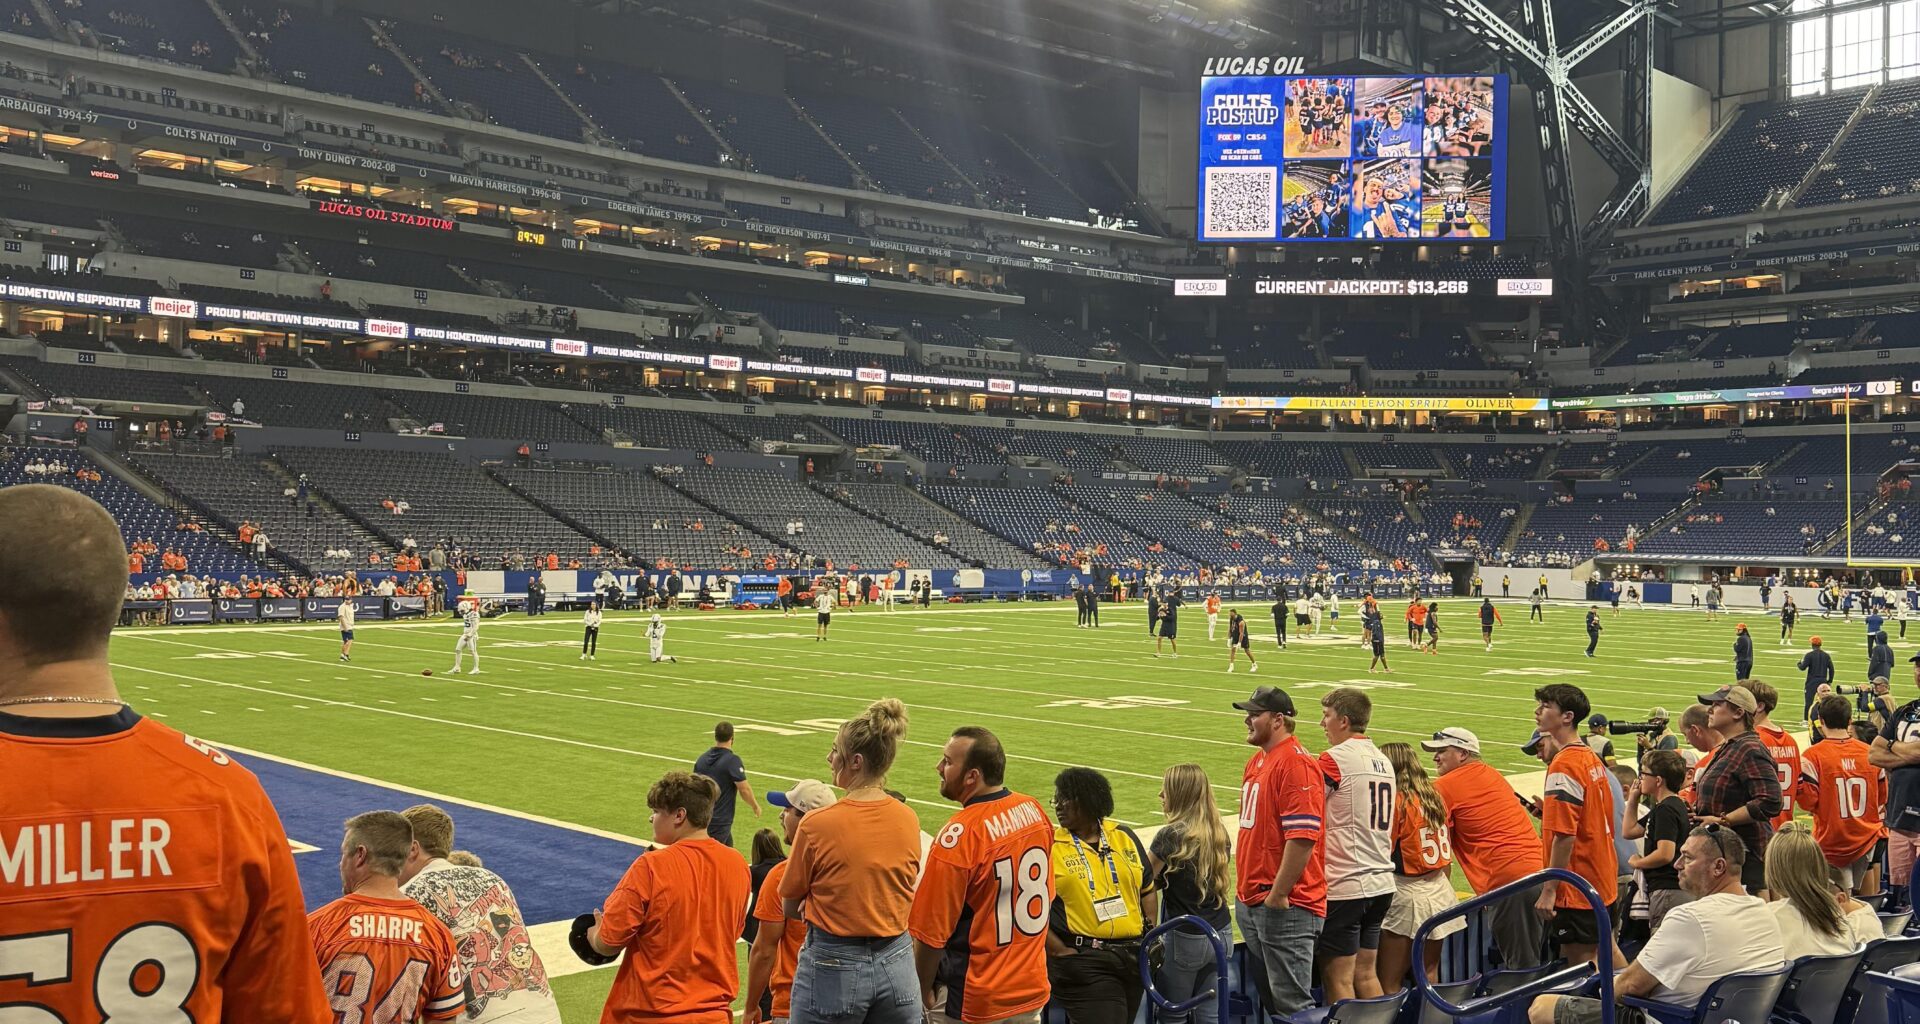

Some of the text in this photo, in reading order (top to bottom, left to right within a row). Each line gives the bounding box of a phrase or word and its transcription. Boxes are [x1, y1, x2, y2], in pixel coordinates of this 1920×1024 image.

[1203, 56, 1304, 75] LUCAS OIL
[1214, 94, 1271, 107] COLTS
[0, 98, 98, 124] ARBAUGH 1994-97
[1207, 106, 1278, 125] POSTUP
[165, 127, 236, 146] COLTS NATION
[297, 148, 395, 172] TONY DUNGY 2002-08
[90, 170, 119, 180] verizon
[450, 175, 560, 200] MARVIN HARRISON 1996-08
[319, 201, 453, 230] LUCAS OIL STADIUM
[608, 201, 701, 223] EDGERRIN JAMES 1999-05
[746, 222, 830, 241] ERIC DICKERSON 1987-91
[562, 238, 576, 249] QTR
[870, 241, 904, 252] MARSHALL
[905, 245, 925, 255] FAULK
[1897, 244, 1920, 253] DWIG
[986, 256, 1001, 265] JEFF
[1001, 258, 1032, 269] SATURDAY
[1756, 251, 1848, 267] ROBERT MATHIS 2003-16
[849, 275, 867, 285] LIGHT
[1086, 269, 1099, 277] BILL
[1634, 271, 1657, 279] TARIK
[1658, 268, 1682, 277] GLENN
[1255, 280, 1468, 296] CURRENT JACKPOT: $13,266
[9, 285, 75, 302] HOMETOWN
[77, 292, 141, 309] SUPPORTER
[154, 300, 191, 315] meijer
[206, 306, 359, 331] PROUD HOMETOWN SUPPORTER
[370, 322, 402, 335] meijer
[414, 327, 546, 349] PROUD HOMETOWN SUPPORTER
[555, 342, 582, 354] meijer
[593, 345, 704, 365] PROUD HOMETOWN SUPPORTER
[79, 354, 94, 363] 211
[712, 357, 738, 368] meijer
[747, 361, 852, 377] PROUD HOMETOWN SUPPORTER
[860, 370, 882, 381] meijer
[891, 373, 984, 388] PROUD HOMETOWN SUPPORTER
[991, 381, 1011, 391] meijer
[1019, 384, 1104, 397] PROUD HOMETOWN SUPPORTER
[1466, 399, 1515, 408] OLIVER
[98, 421, 113, 429] 111
[1371, 758, 1386, 774] NIX
[1841, 758, 1857, 770] NIX
[1240, 781, 1260, 829] 10
[1835, 777, 1867, 818] 10
[1368, 781, 1392, 831] 10
[1419, 823, 1450, 866] 58
[0, 818, 173, 888] MILLER
[993, 846, 1050, 946] 18
[349, 913, 424, 943] SHARPE
